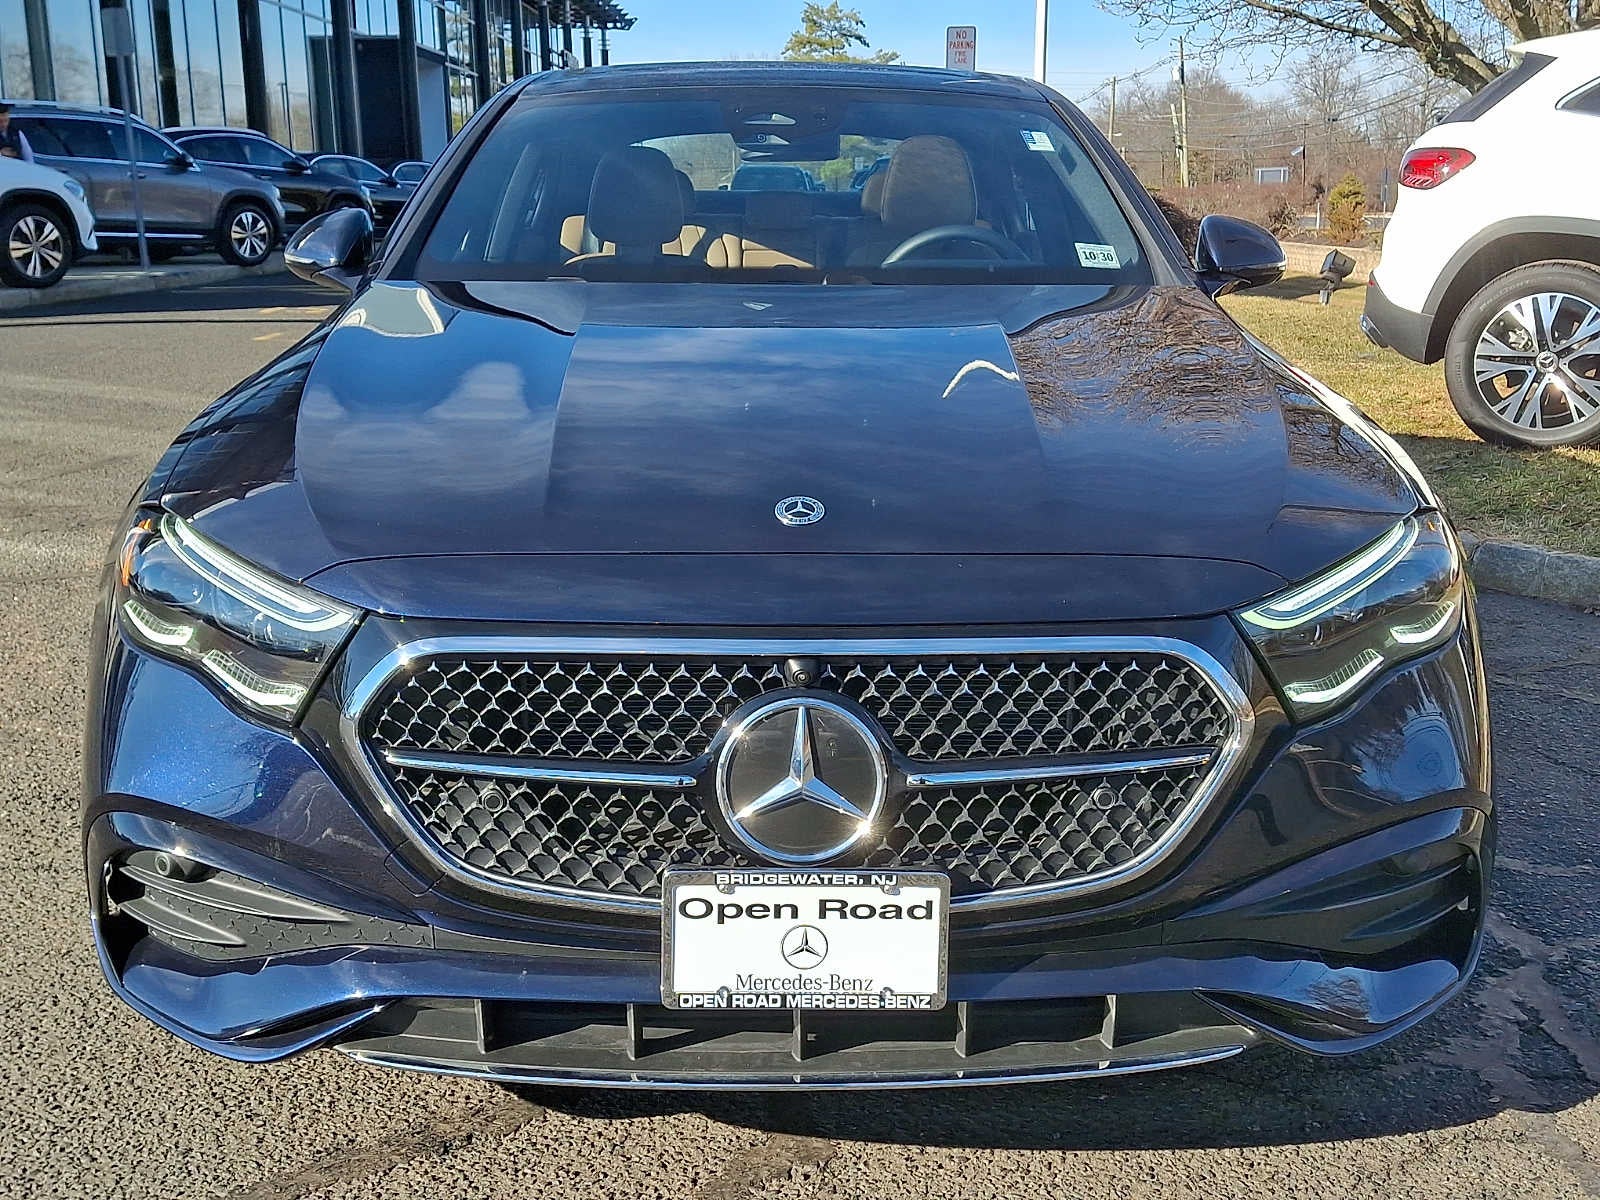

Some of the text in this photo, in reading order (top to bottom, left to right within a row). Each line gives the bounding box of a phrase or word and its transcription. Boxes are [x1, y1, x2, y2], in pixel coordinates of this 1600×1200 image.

[955, 30, 967, 39] NO
[949, 41, 974, 49] PARKING
[716, 874, 898, 886] BRIDGEWATER, NJ
[678, 897, 933, 924] Open Road
[735, 973, 873, 992] Mercedes-Benz
[679, 994, 932, 1009] OPEN ROAD MERCEDES-BENZ
